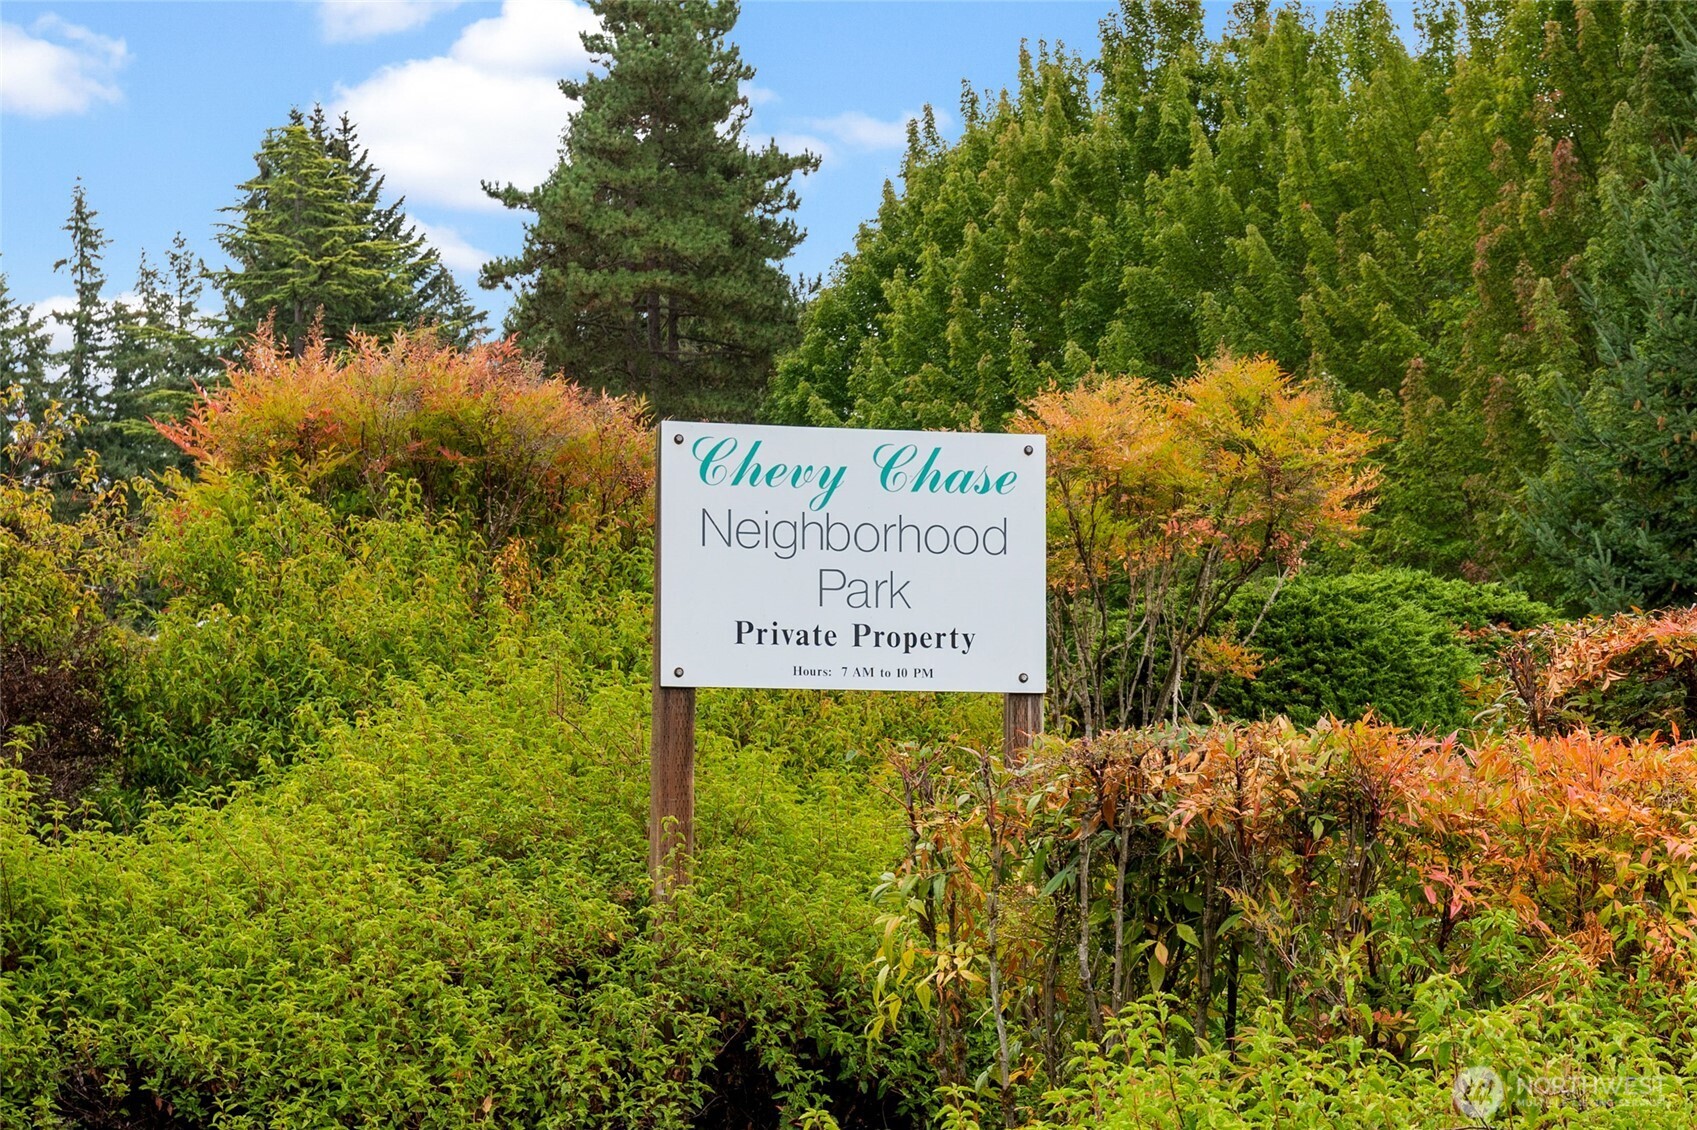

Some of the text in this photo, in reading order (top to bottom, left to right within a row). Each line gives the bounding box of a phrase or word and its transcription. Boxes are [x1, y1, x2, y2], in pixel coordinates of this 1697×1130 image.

[691, 436, 1018, 512] Chevy Chase
[701, 507, 1007, 560] Neighborhood
[818, 568, 912, 609] Park
[734, 620, 976, 655] Private Property
[792, 665, 934, 679] Hours: 7 AM to 10 PM
